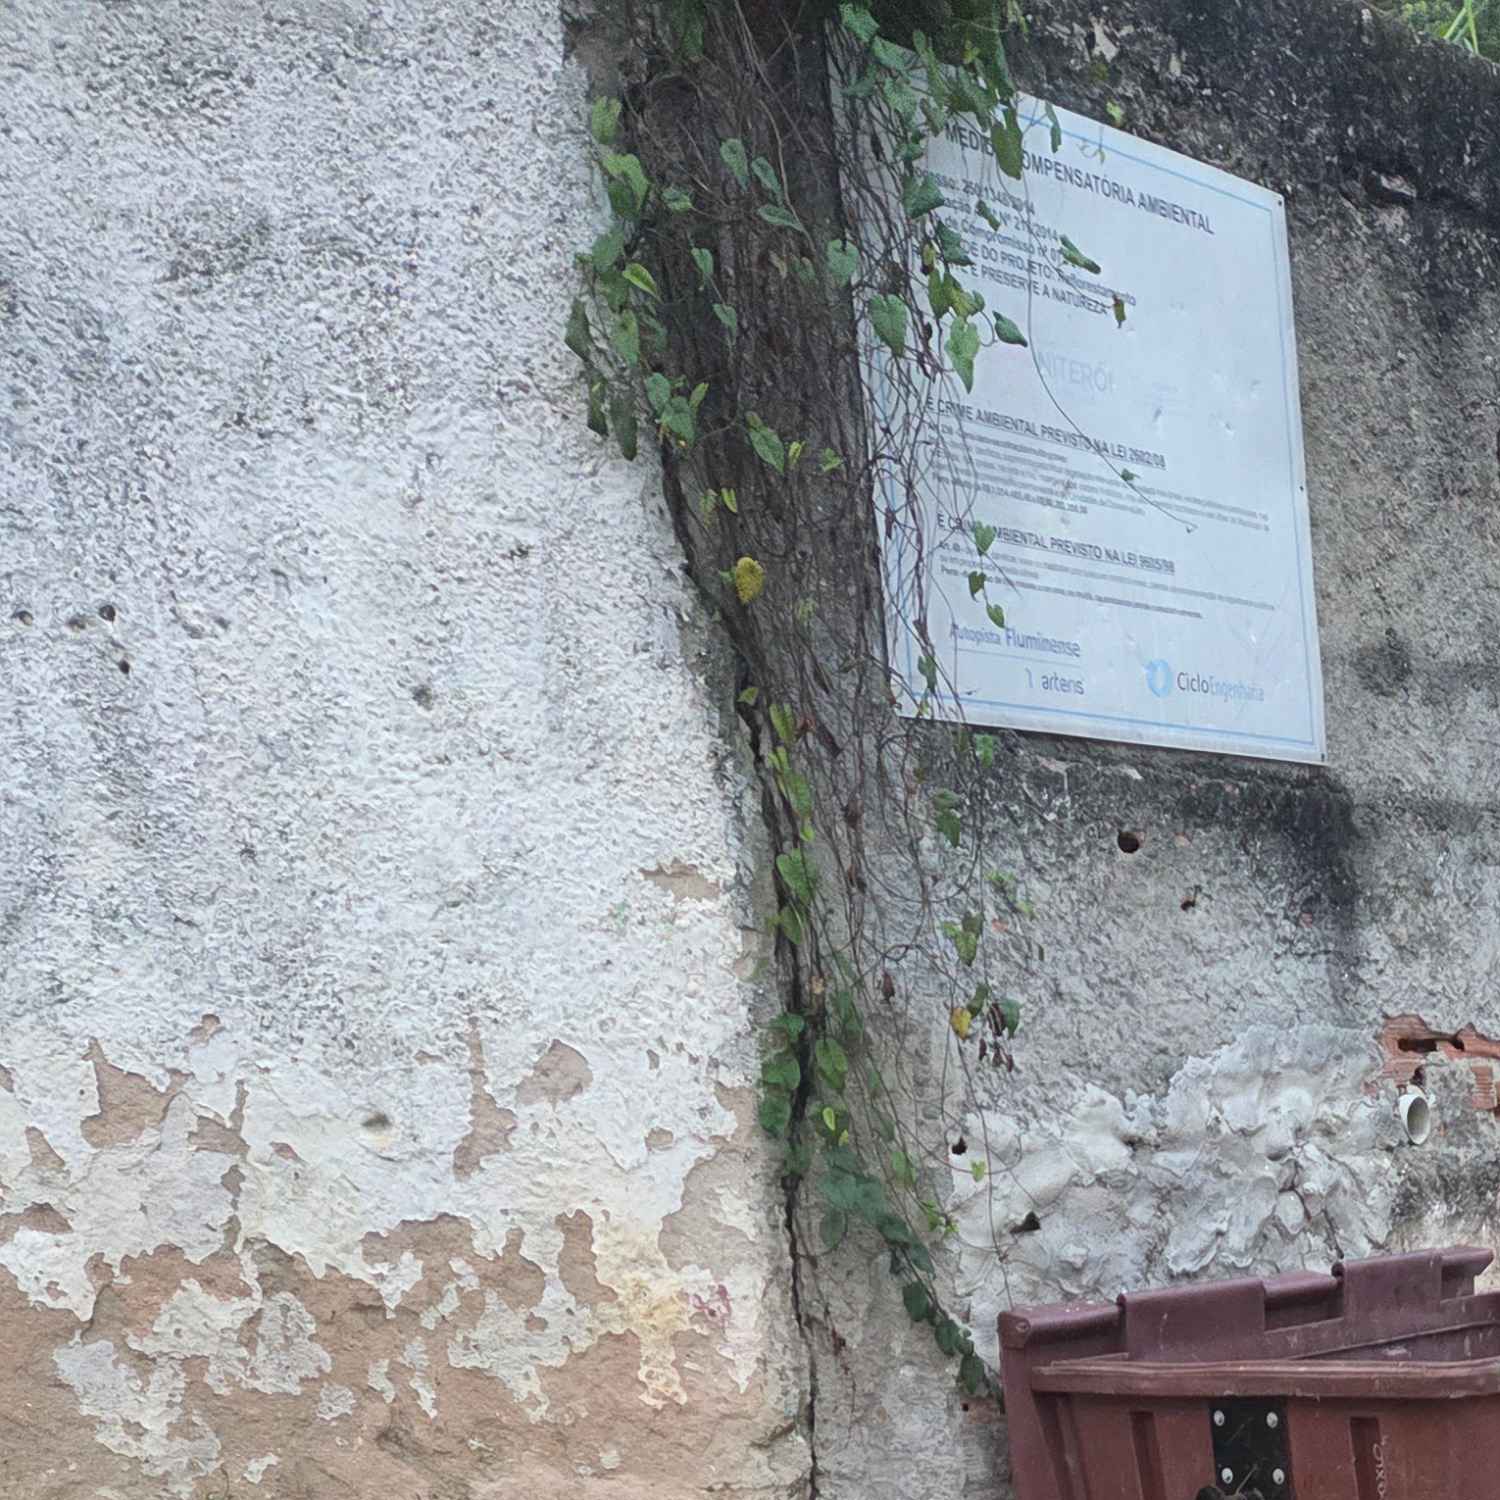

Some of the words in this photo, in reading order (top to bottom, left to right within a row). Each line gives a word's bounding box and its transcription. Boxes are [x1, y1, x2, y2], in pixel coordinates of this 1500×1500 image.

[944, 121, 995, 157] MEDID
[1022, 151, 1137, 206] OMPENSATÓRIA
[1138, 191, 1215, 235] AMBIENTAL
[981, 244, 997, 262] DO
[981, 265, 1041, 296] PRESERVE
[975, 408, 1039, 437] AMBIENTAL
[1040, 424, 1092, 450] PREVISTO
[1110, 442, 1127, 459] LEI
[1050, 537, 1102, 560] PREVISTO
[1104, 548, 1120, 563] NA
[1121, 551, 1137, 567] LEI
[1004, 627, 1081, 658] Fluminense
